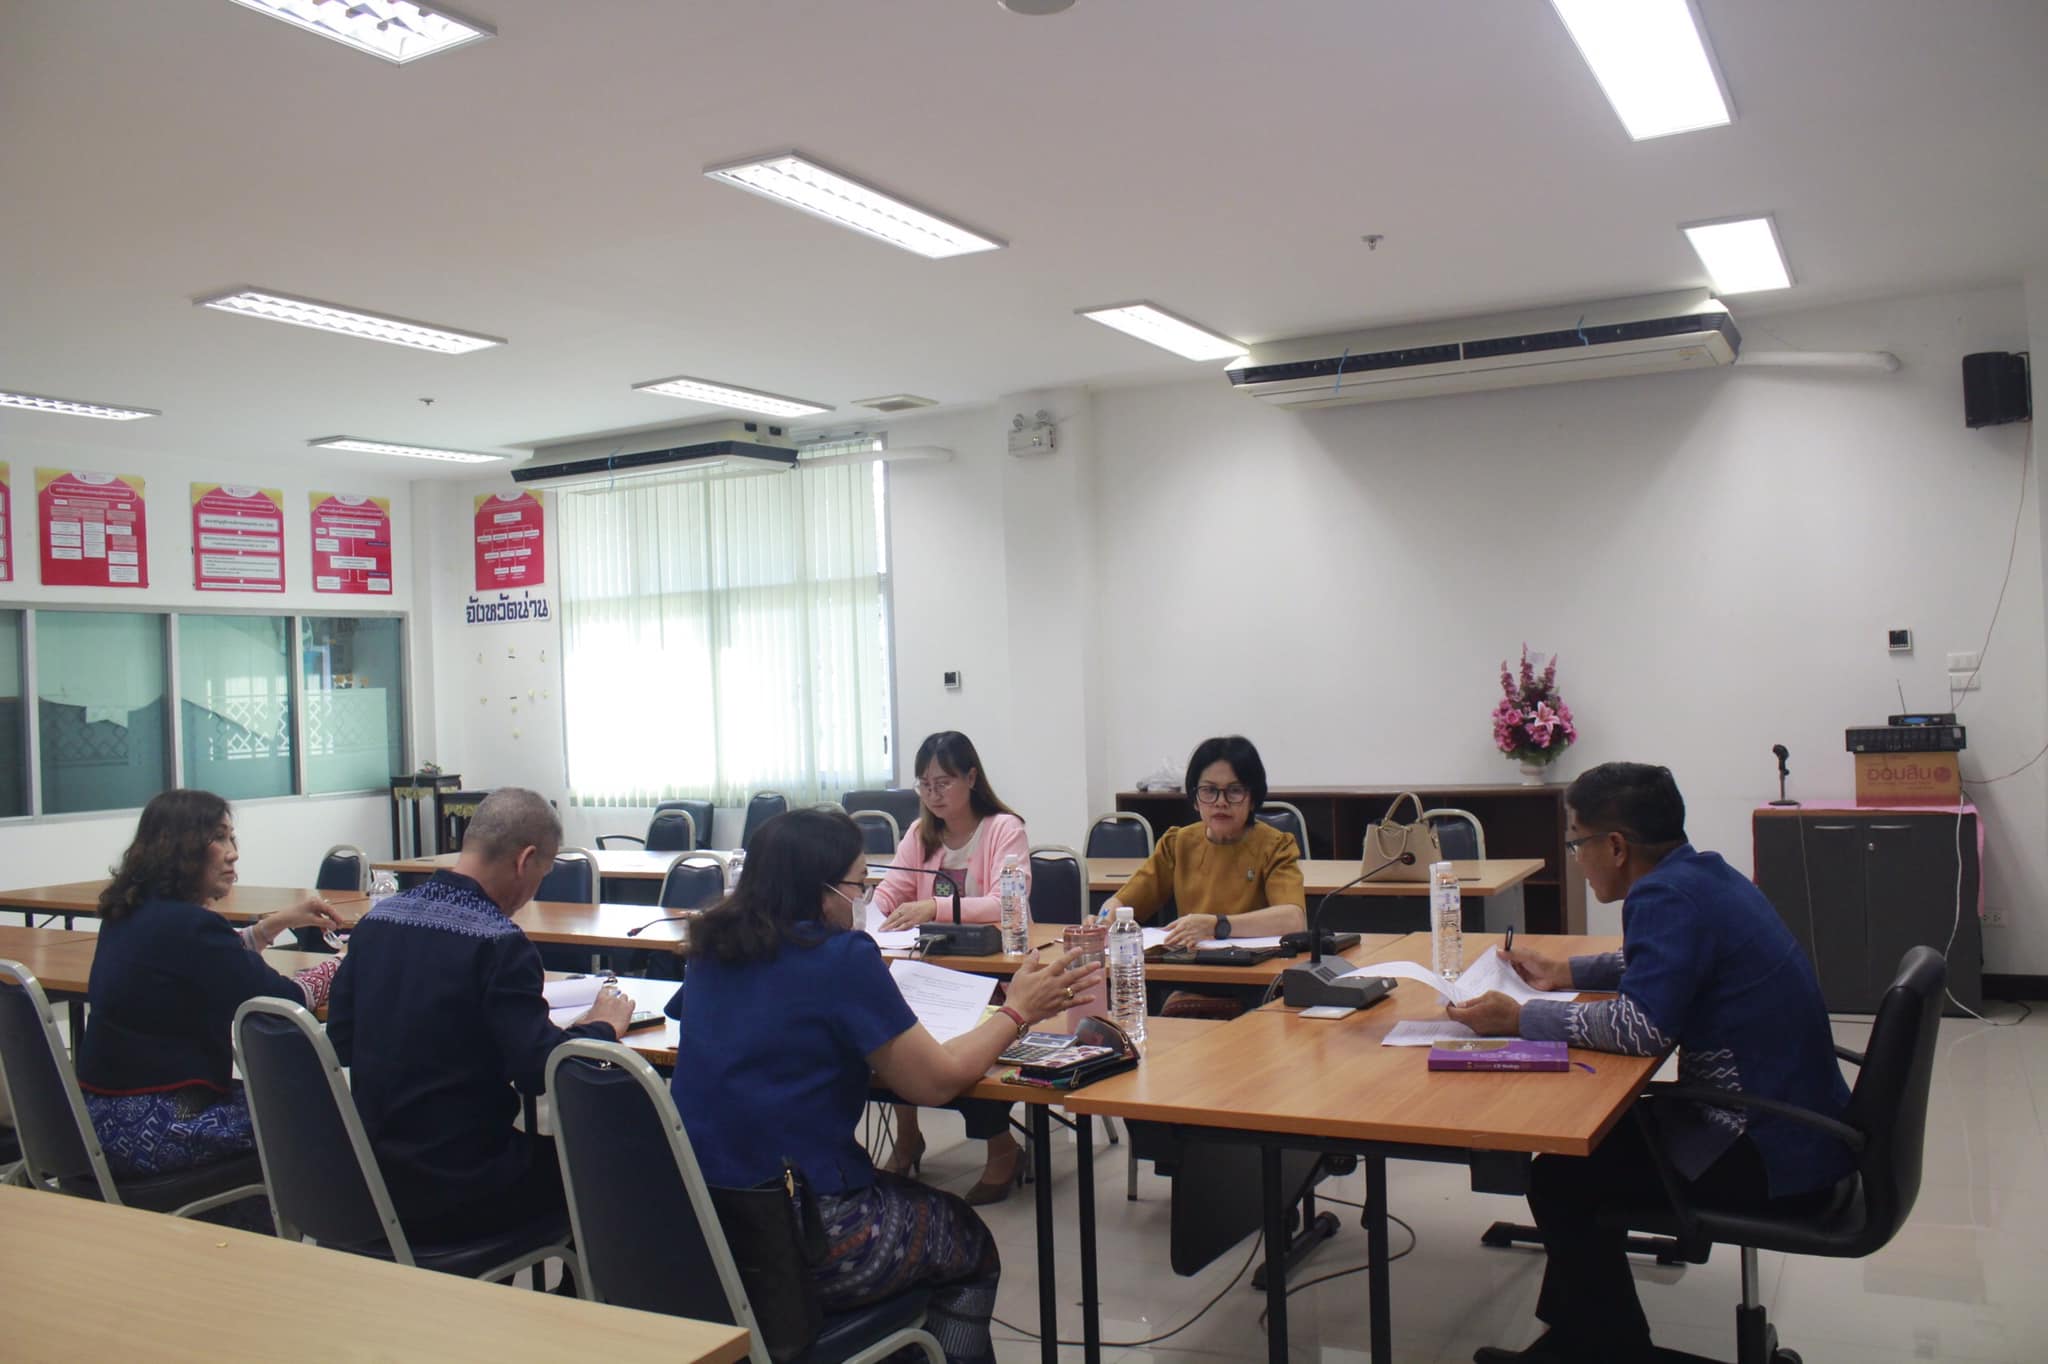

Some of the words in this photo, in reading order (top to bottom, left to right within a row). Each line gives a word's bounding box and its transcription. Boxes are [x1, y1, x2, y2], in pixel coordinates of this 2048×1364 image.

[466, 590, 548, 623] จังหวัดน่าน
